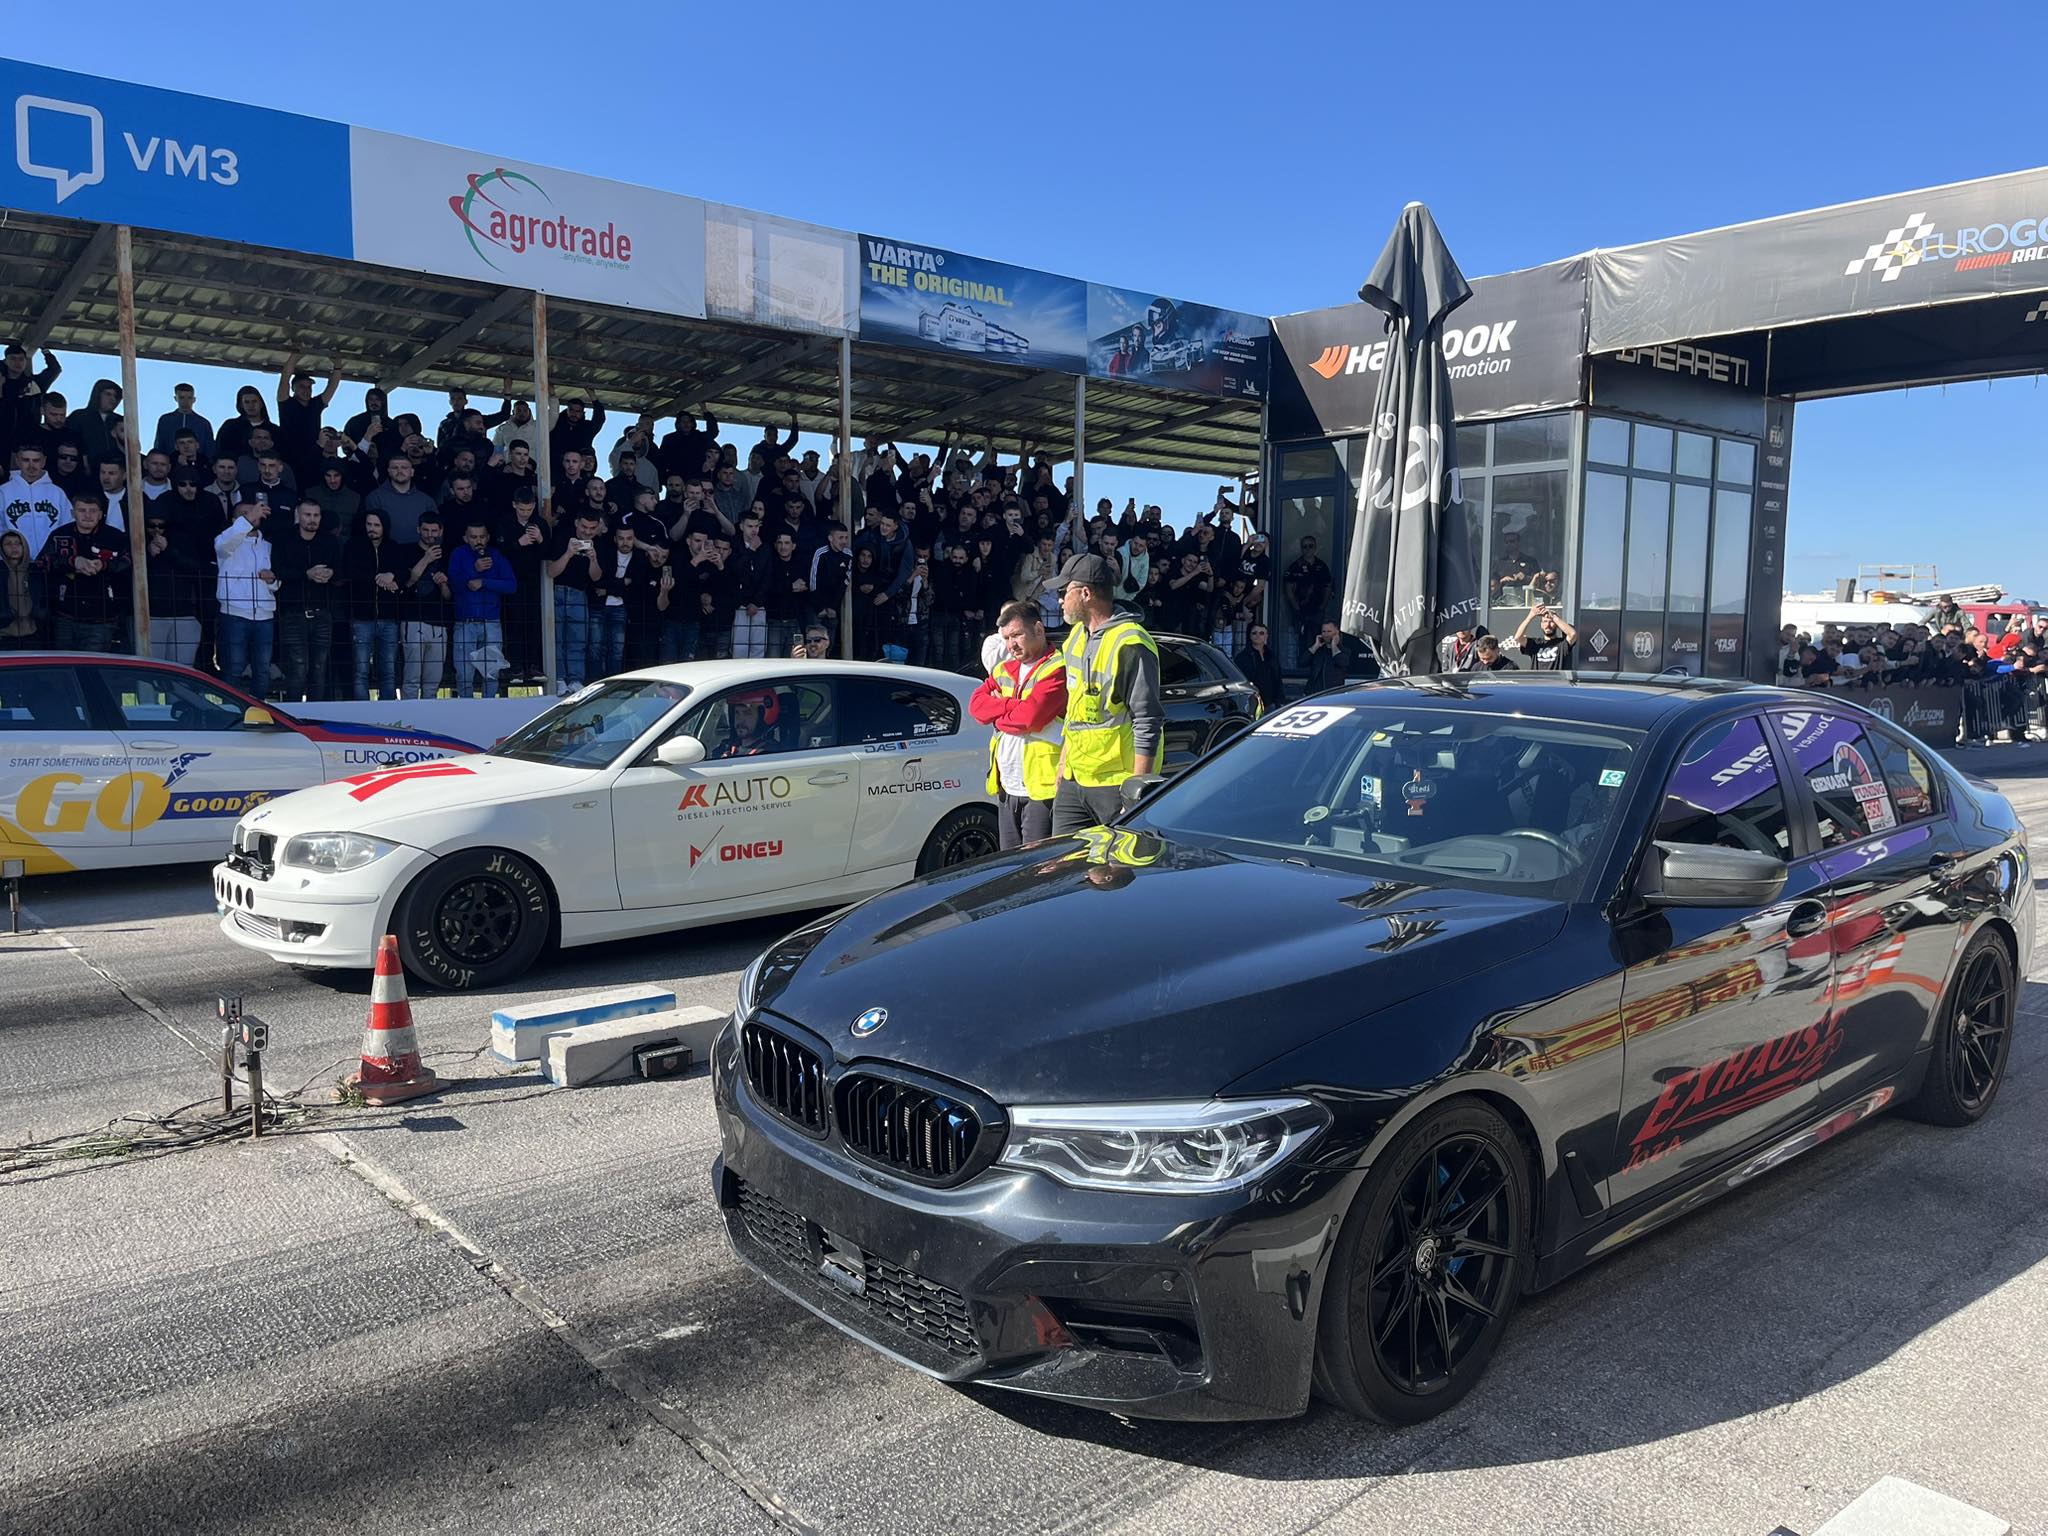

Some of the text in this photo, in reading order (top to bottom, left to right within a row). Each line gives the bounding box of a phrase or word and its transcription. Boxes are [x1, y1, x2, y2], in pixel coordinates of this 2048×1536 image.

[123, 131, 239, 185] VM3
[490, 210, 631, 262] agrotrade
[868, 262, 908, 288] THE
[1272, 710, 1329, 729] 59
[384, 737, 411, 745] SAFETY
[864, 743, 897, 754] DAS
[9, 757, 41, 768] START
[42, 757, 100, 767] SOMETHING
[102, 756, 134, 767] GREAT
[713, 776, 790, 806] AUTO
[868, 780, 961, 796] MACTURBO.EU
[1854, 783, 1886, 800] TUNING
[16, 771, 171, 833] GO
[677, 801, 792, 821] DIESEL INJECTION SERVICE
